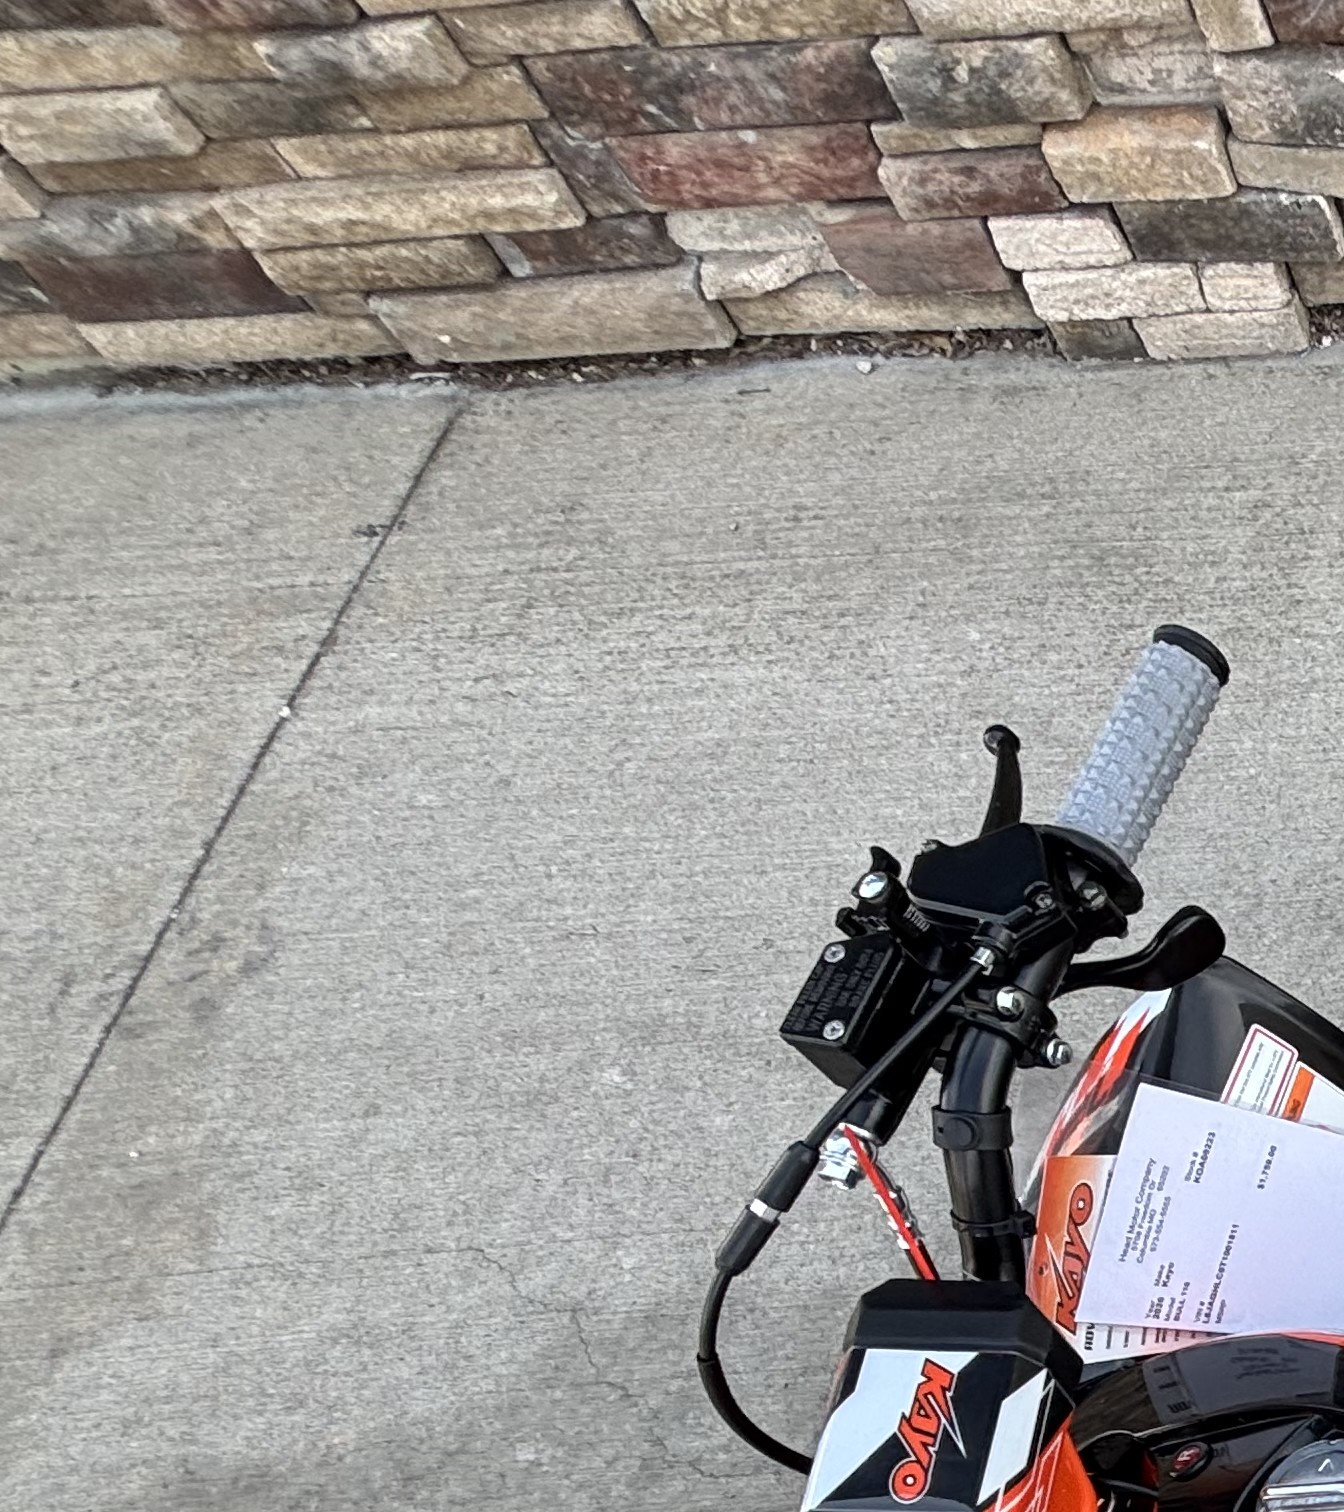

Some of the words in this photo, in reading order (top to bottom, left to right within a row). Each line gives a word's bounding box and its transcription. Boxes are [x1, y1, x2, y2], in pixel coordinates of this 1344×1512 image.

[1135, 1158, 1156, 1204] Company
[1126, 1206, 1140, 1234] Motor
[1118, 1236, 1135, 1262] Head
[1161, 1262, 1174, 1287] Kayo
[1144, 1300, 1155, 1319] Year
[890, 1358, 967, 1504] KAYO
